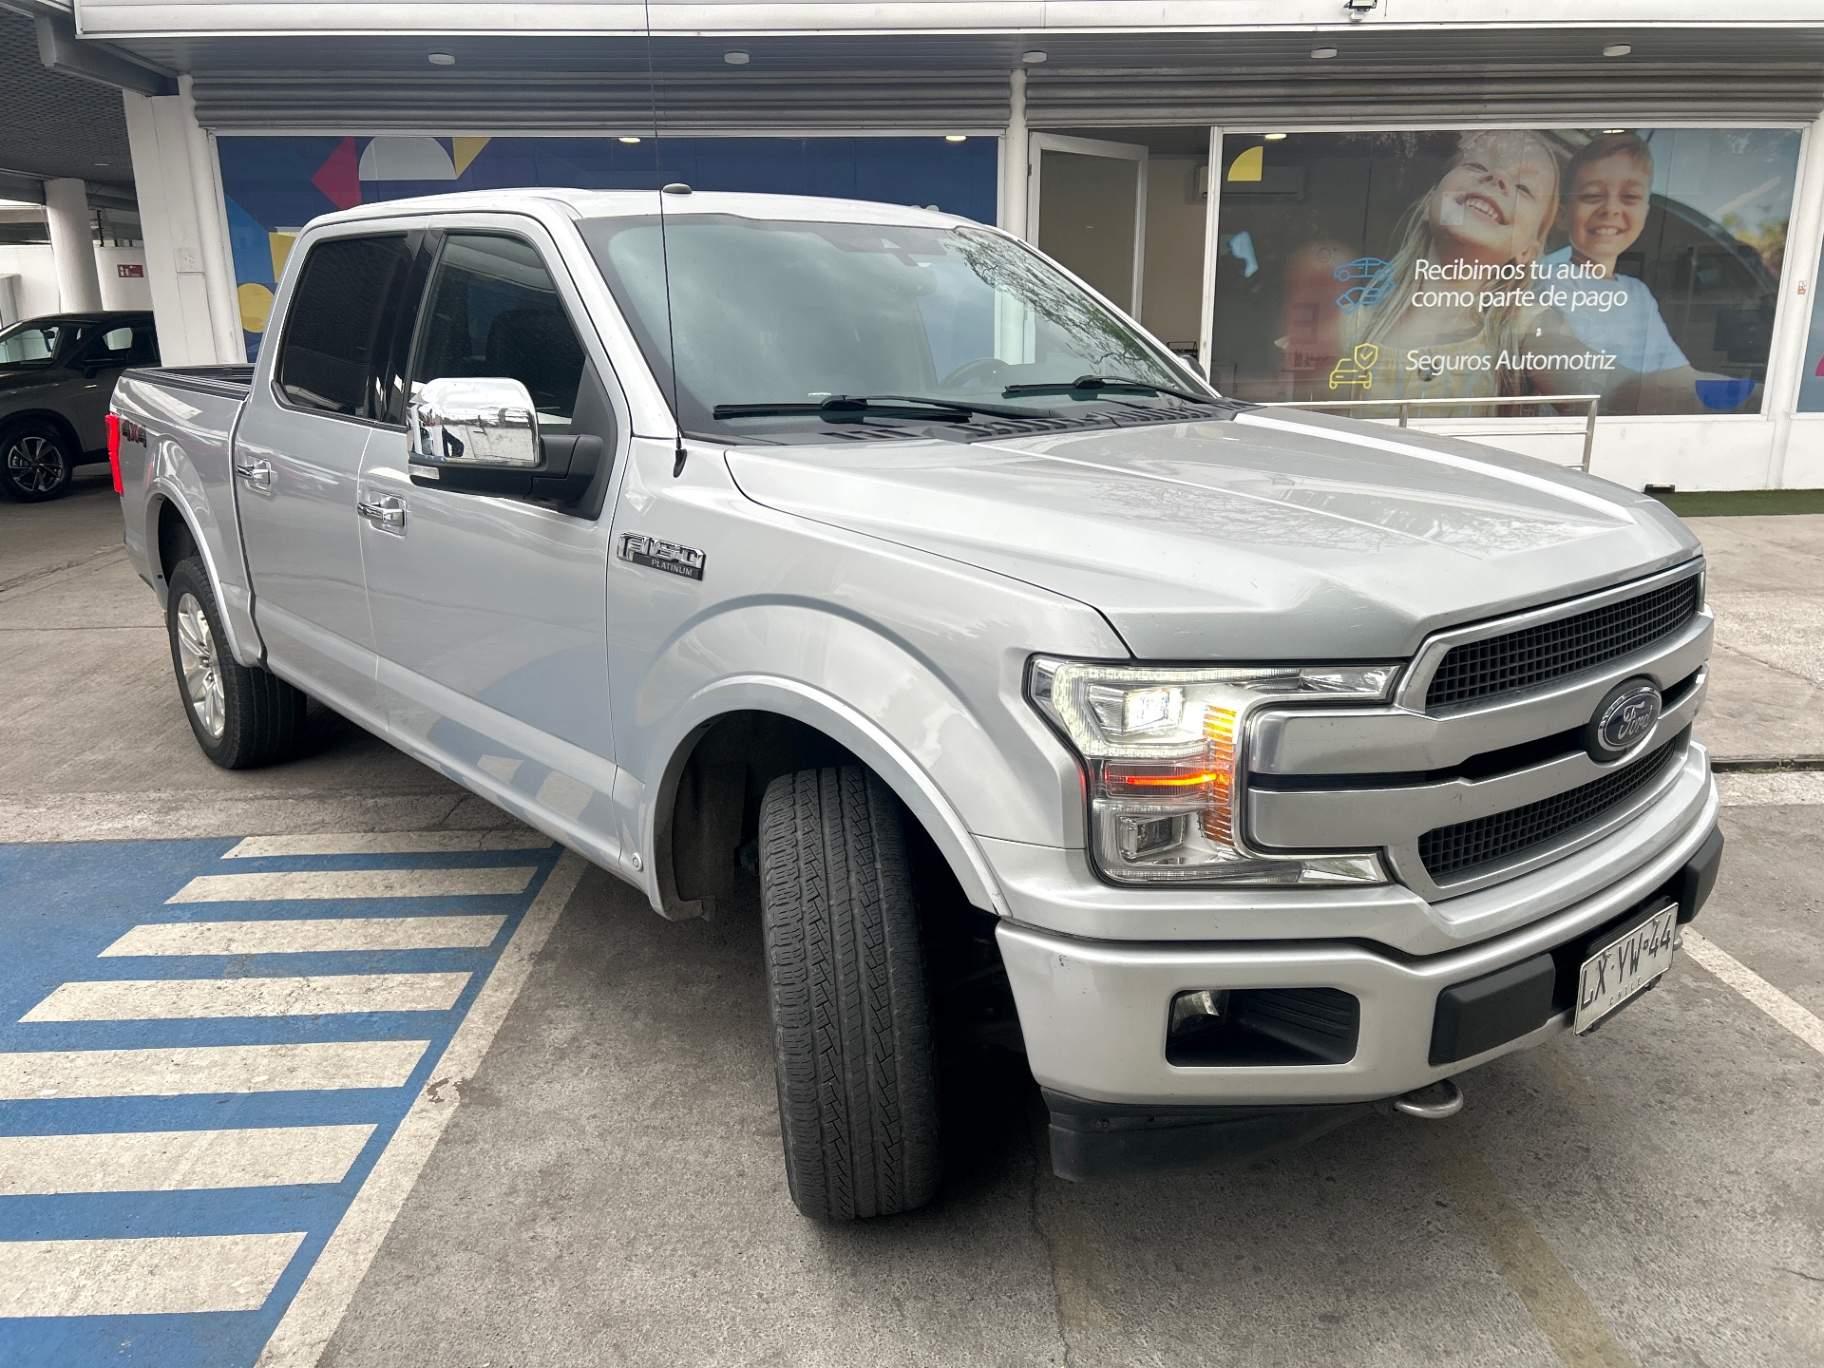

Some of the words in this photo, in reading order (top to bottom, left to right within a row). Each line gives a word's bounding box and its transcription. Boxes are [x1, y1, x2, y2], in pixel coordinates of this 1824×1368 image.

[1414, 258, 1526, 281] Recibimos
[1530, 260, 1553, 280] tu
[1556, 259, 1607, 280] auto
[1411, 290, 1475, 308] como
[1478, 287, 1536, 313] parte
[1538, 285, 1568, 307] de
[1570, 289, 1629, 313] pago
[1405, 350, 1492, 376] Seguros
[1495, 349, 1617, 371] Automotriz
[651, 558, 694, 577] PLATINUM
[1617, 701, 1653, 740] Ford
